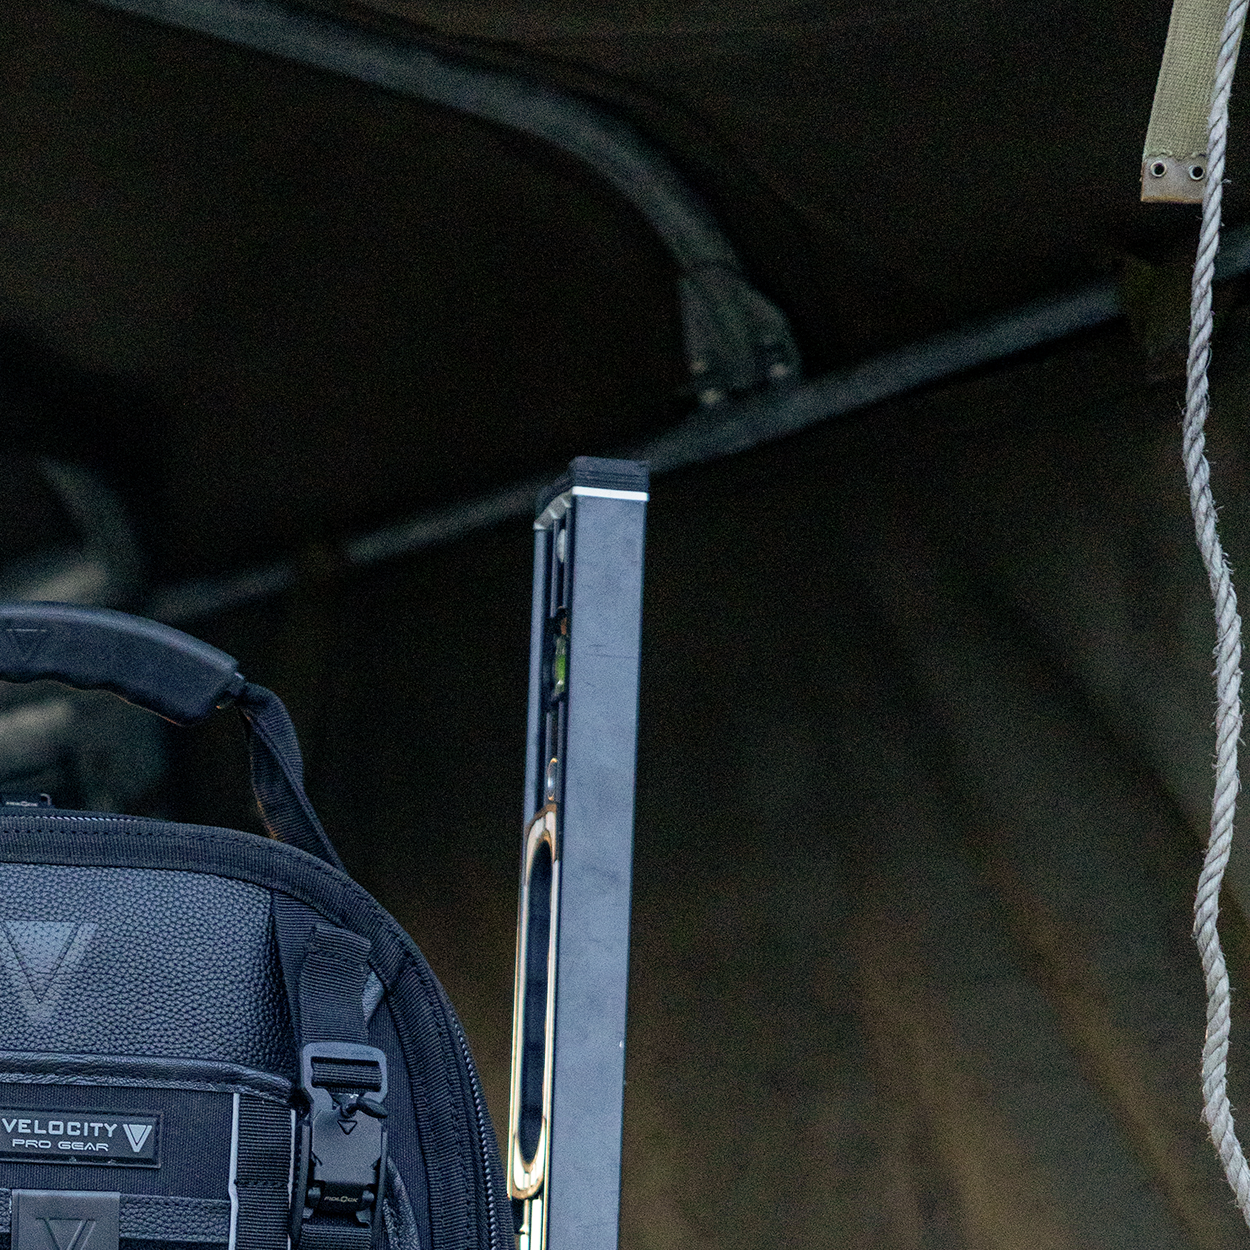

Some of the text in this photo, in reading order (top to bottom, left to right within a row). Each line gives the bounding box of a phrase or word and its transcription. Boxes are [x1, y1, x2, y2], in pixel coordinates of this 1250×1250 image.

[2, 1118, 117, 1138] VELOCITY
[12, 1139, 109, 1152] PRO GEAR
